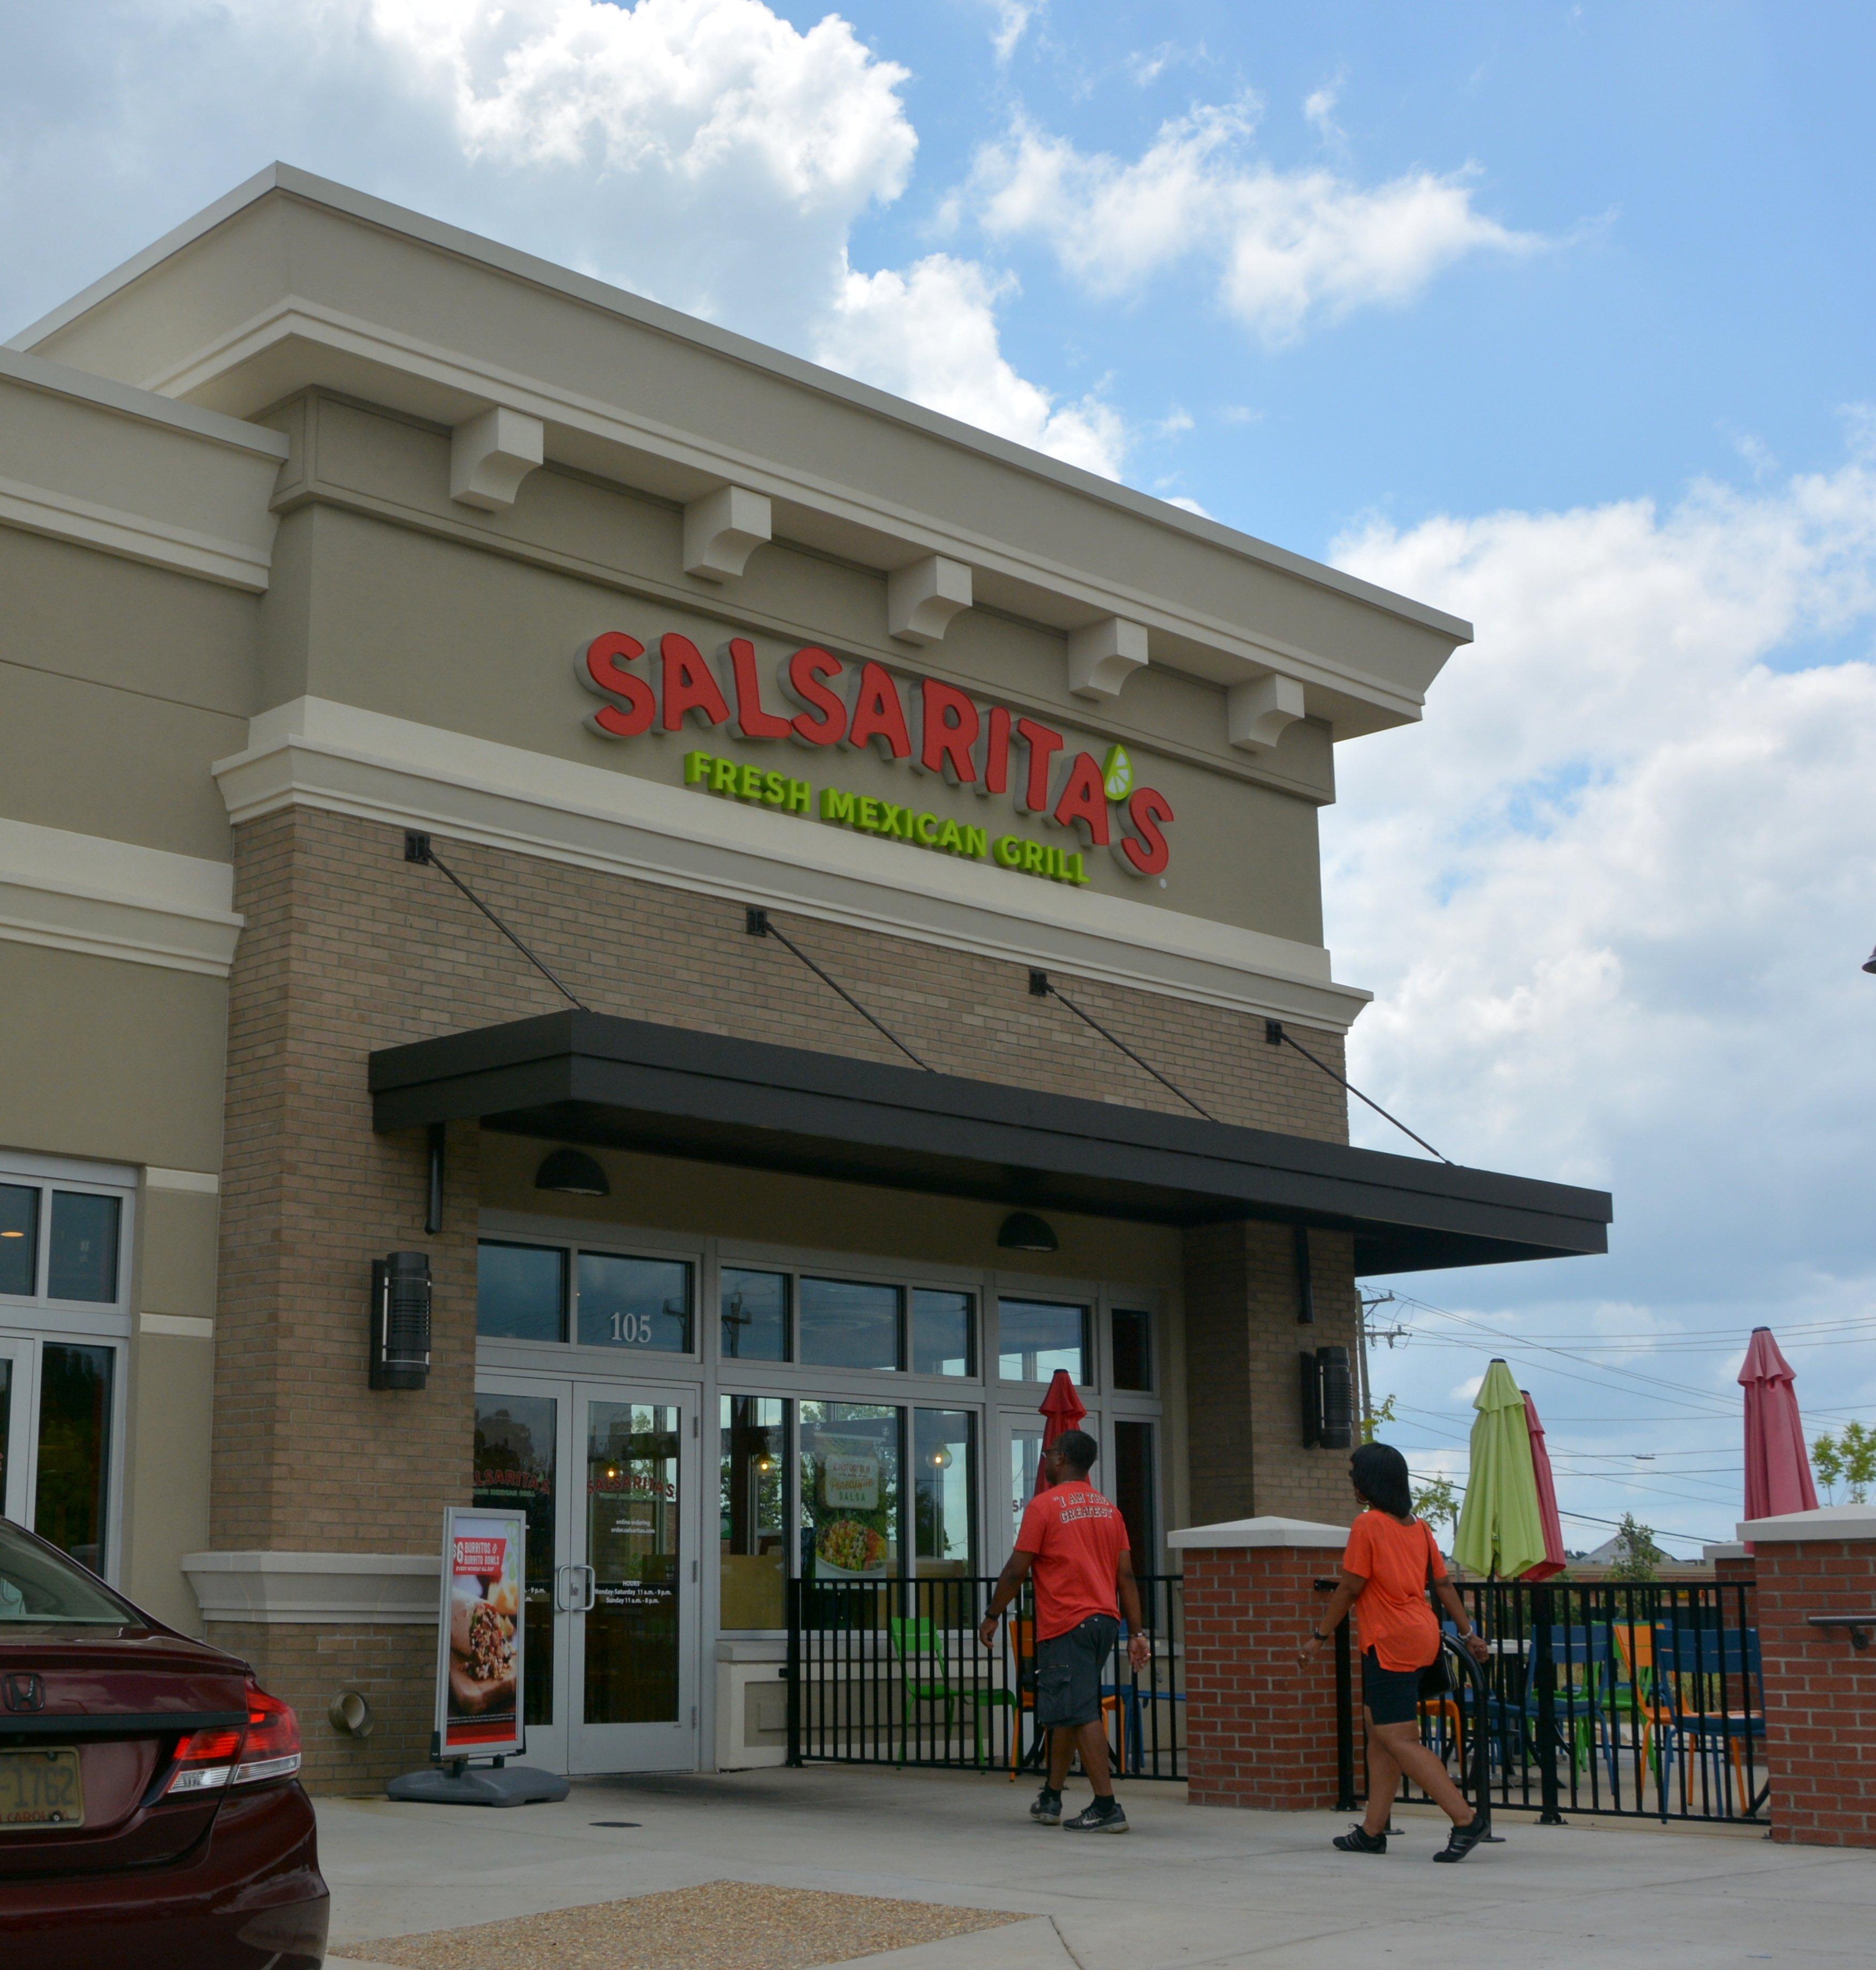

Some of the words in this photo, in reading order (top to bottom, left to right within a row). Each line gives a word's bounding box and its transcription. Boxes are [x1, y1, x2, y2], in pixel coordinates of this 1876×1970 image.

[685, 751, 811, 813] FRESH
[820, 787, 987, 858] MEXICAN
[992, 835, 1091, 884] GRILL
[610, 1312, 651, 1343] 105
[839, 1491, 865, 1502] SALSA
[1069, 1492, 1085, 1505] AM
[1059, 1506, 1113, 1524] GREATEST
[464, 1542, 491, 1554] BURRITOS
[464, 1555, 483, 1565] BURRITO
[484, 1555, 500, 1565] BOWLS
